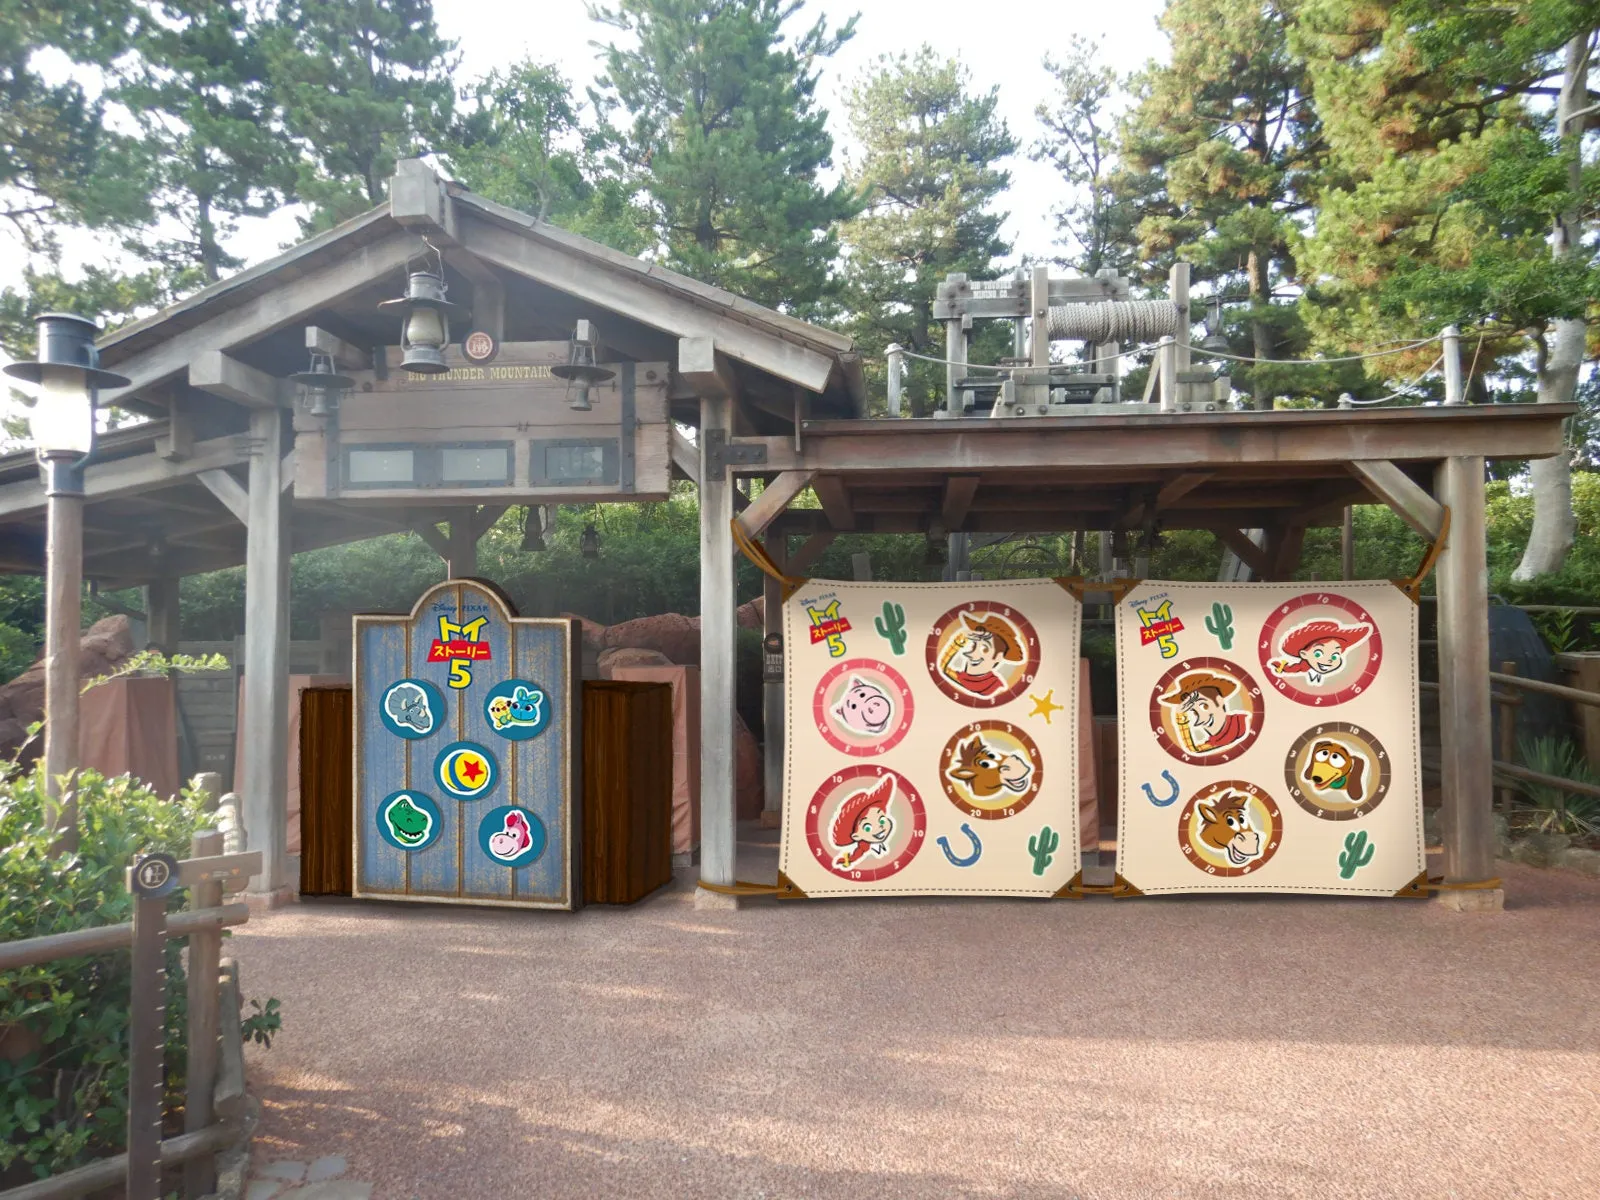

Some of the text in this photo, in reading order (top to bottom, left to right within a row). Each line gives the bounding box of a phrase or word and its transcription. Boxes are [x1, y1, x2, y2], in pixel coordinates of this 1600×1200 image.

[432, 368, 485, 381] THUNDER
[490, 366, 551, 380] MOUNTAIN
[1317, 594, 1329, 604] 10
[806, 599, 842, 628] トイ
[1136, 599, 1174, 629] トイ
[1360, 612, 1367, 620] 5
[437, 614, 490, 644] トイ
[812, 621, 848, 639] ストーリー
[1143, 623, 1181, 640] ストーリー
[827, 633, 847, 658] 5
[1030, 637, 1034, 646] 1
[1157, 633, 1179, 659] 5
[1261, 640, 1269, 649] 3
[434, 645, 488, 658] ストーリー
[1371, 653, 1379, 661] 3
[876, 663, 886, 672] 10
[930, 662, 935, 671] 2
[1182, 662, 1191, 670] 8
[447, 657, 473, 690] 5
[1021, 674, 1033, 684] 10
[1275, 678, 1286, 690] 10
[1351, 683, 1362, 694] 10
[1248, 687, 1260, 699] 10
[1314, 697, 1322, 705] 5
[819, 722, 829, 733] 10
[969, 723, 981, 731] 20
[1006, 724, 1012, 733] 3
[1350, 726, 1360, 735] 10
[875, 745, 885, 754] 10
[1031, 749, 1036, 757] 5
[1290, 750, 1297, 758] 3
[1378, 751, 1385, 759] 5
[876, 767, 882, 776] 5
[832, 775, 843, 783] 10
[947, 785, 953, 793] 5
[1209, 784, 1218, 793] 3
[1246, 783, 1258, 794] 20
[1289, 786, 1300, 796] 10
[1378, 785, 1385, 793] 3
[910, 793, 916, 802] 3
[811, 805, 817, 814] 8
[970, 809, 981, 817] 20
[1271, 809, 1279, 818] 3
[1317, 808, 1324, 817] 5
[1353, 807, 1363, 818] 10
[1183, 812, 1191, 820] 5
[1182, 843, 1192, 854] 20
[1269, 841, 1277, 850] 5
[816, 848, 822, 856] 3
[893, 860, 900, 870] 5
[1204, 865, 1216, 874] 10
[850, 871, 861, 879] 10
